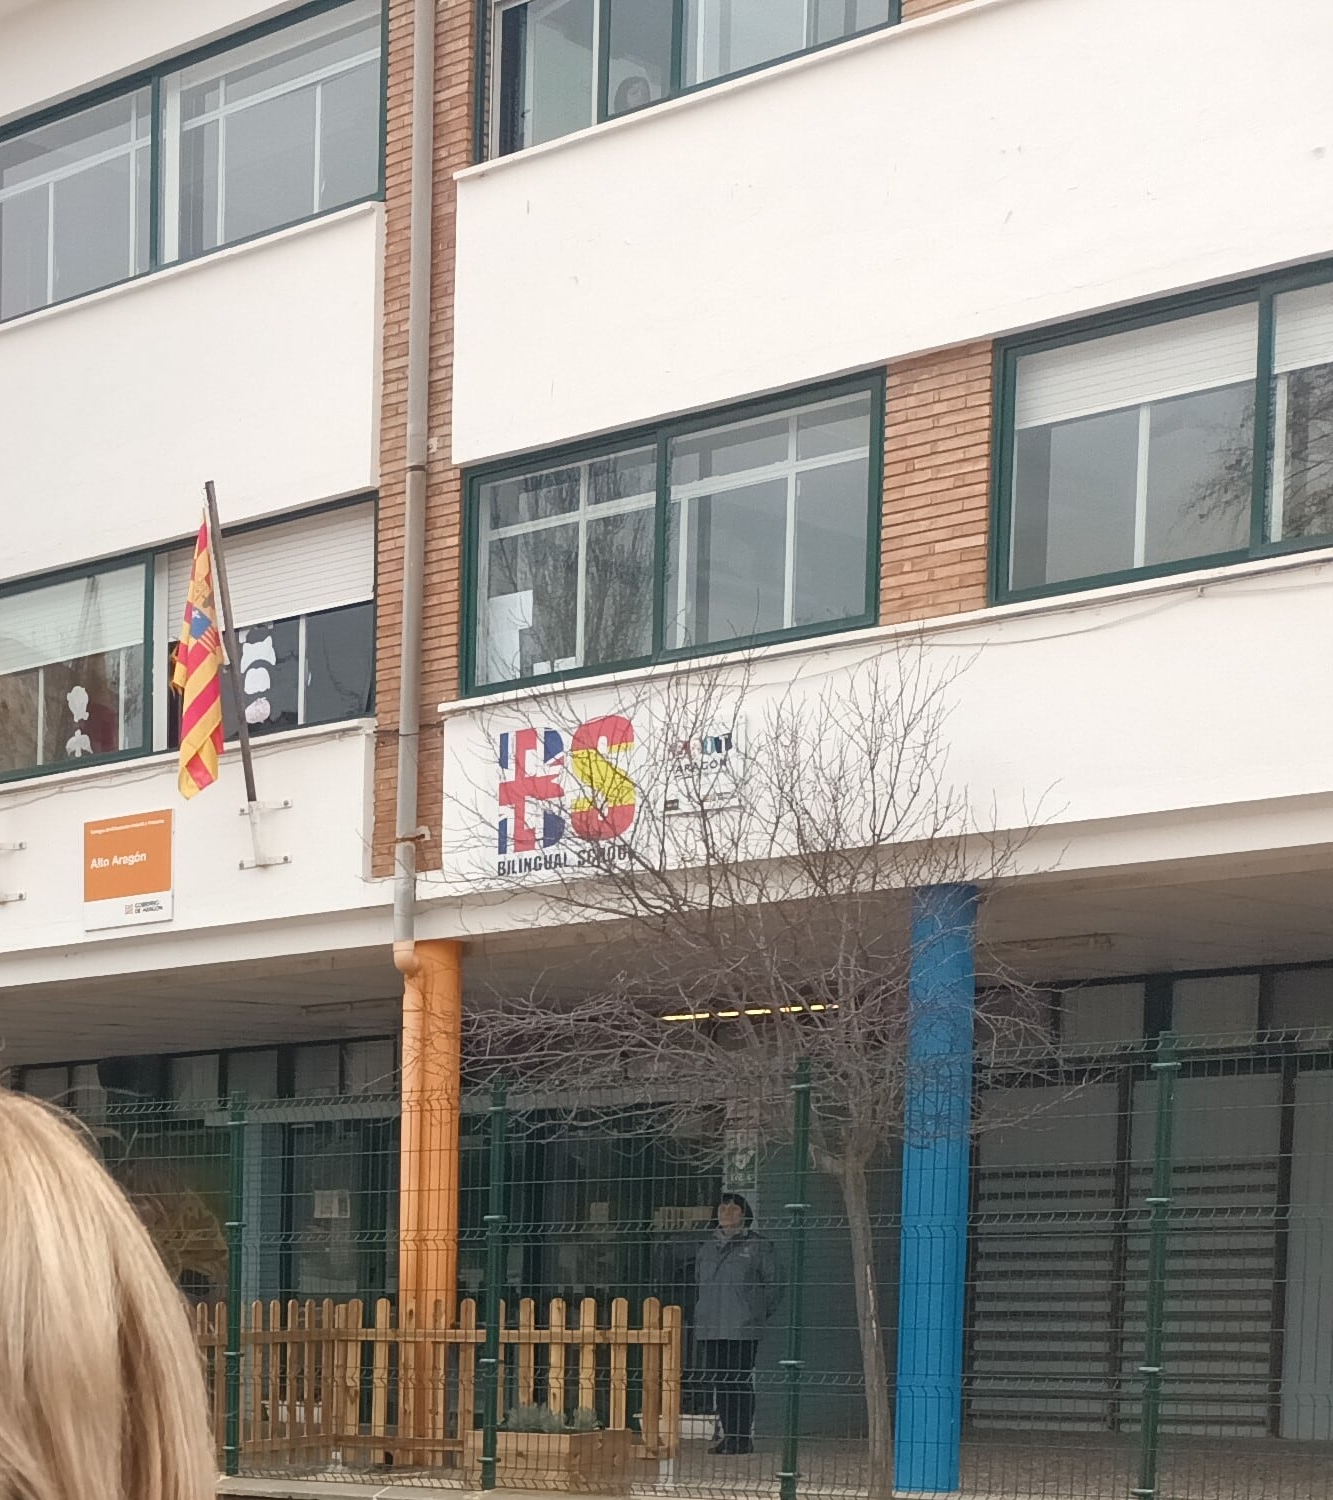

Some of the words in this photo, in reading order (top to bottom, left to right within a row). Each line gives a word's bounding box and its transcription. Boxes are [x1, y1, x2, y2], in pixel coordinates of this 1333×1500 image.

[90, 857, 110, 870] Alto
[111, 851, 147, 866] Aragón
[497, 852, 569, 876] BILINGUAL
